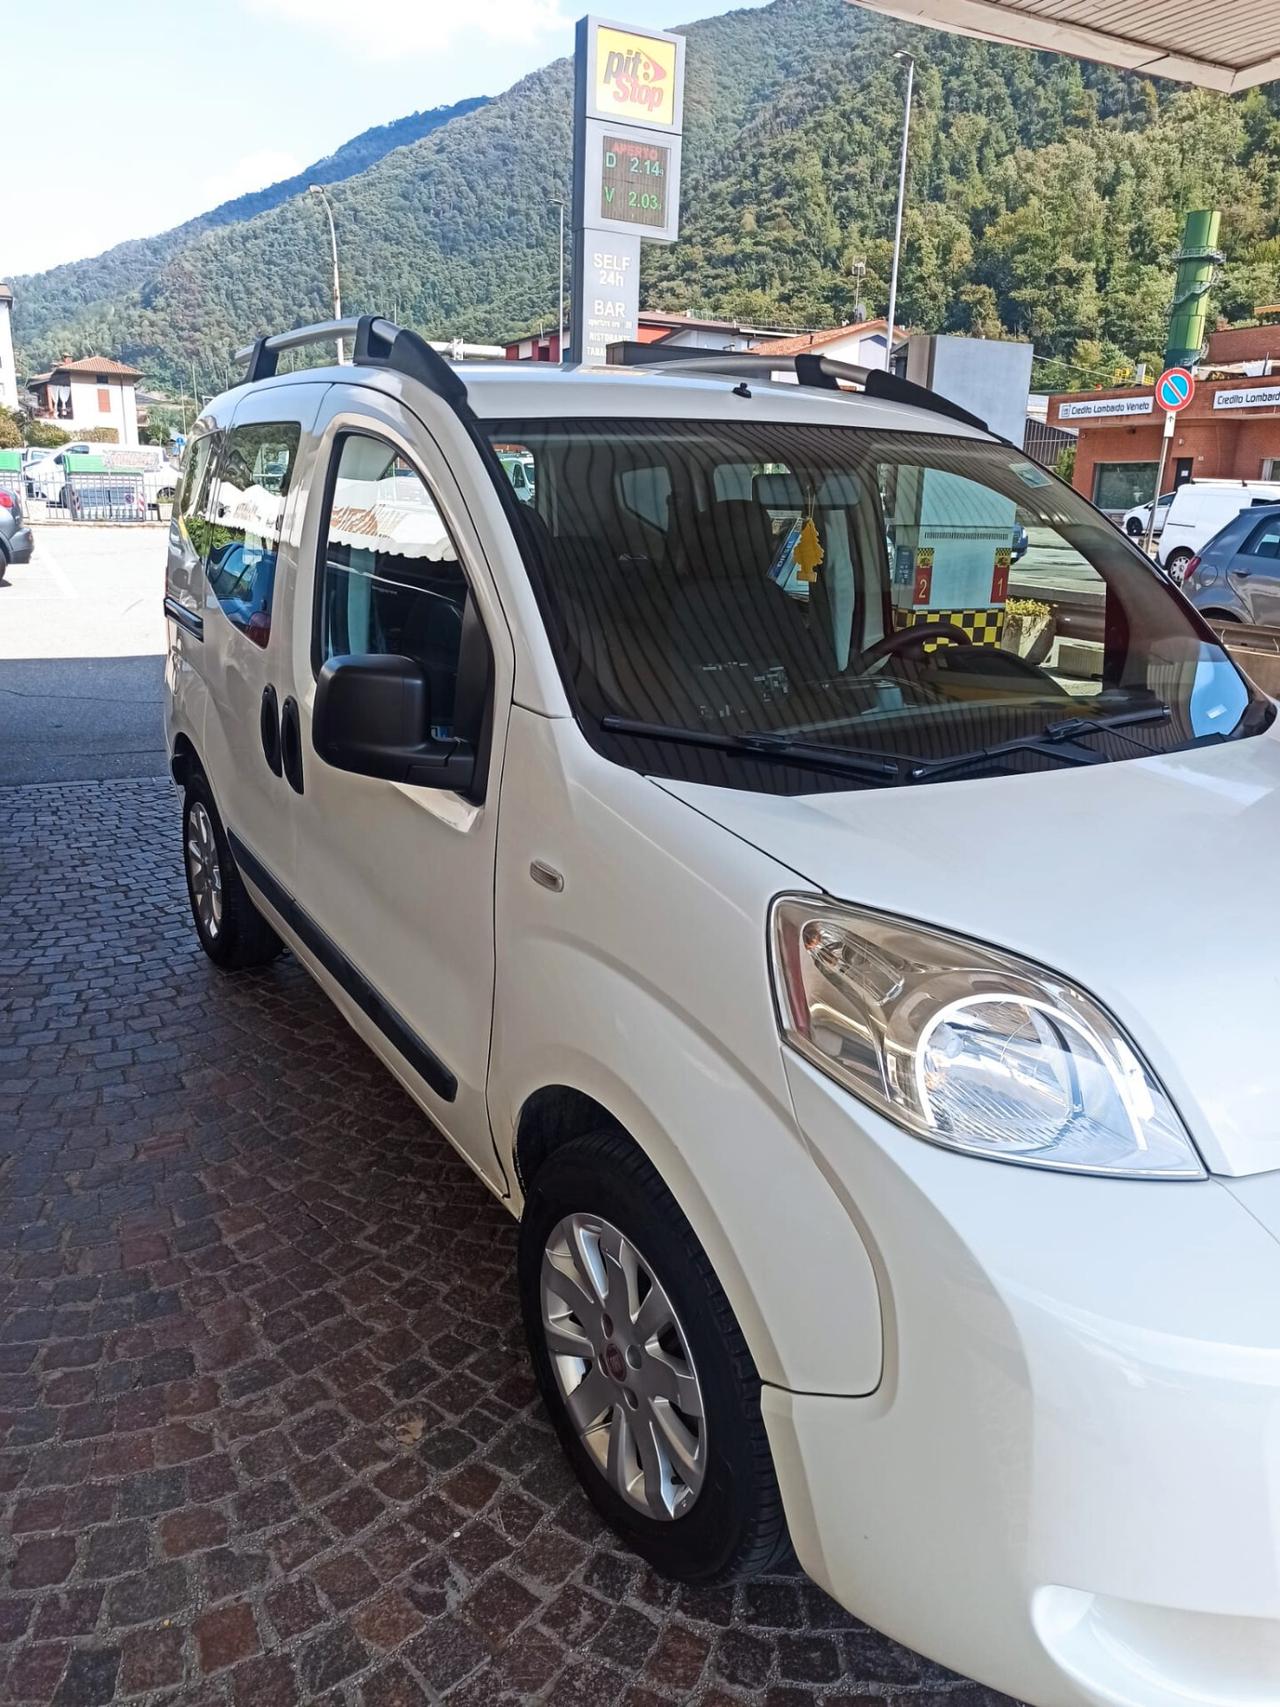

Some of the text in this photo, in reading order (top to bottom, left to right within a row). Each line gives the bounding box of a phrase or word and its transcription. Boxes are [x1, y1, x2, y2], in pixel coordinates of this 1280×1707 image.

[603, 49, 641, 84] pit
[605, 151, 616, 168] D
[604, 186, 615, 202] V
[593, 253, 630, 271] SELF
[600, 270, 624, 287] 24h
[594, 300, 625, 317] BAR
[1071, 405, 1092, 415] Credito
[1093, 403, 1124, 414] Lombardo
[1126, 401, 1149, 411] Veneto
[1217, 394, 1244, 405] Credito
[918, 578, 928, 599] 2
[997, 577, 1004, 597] 1
